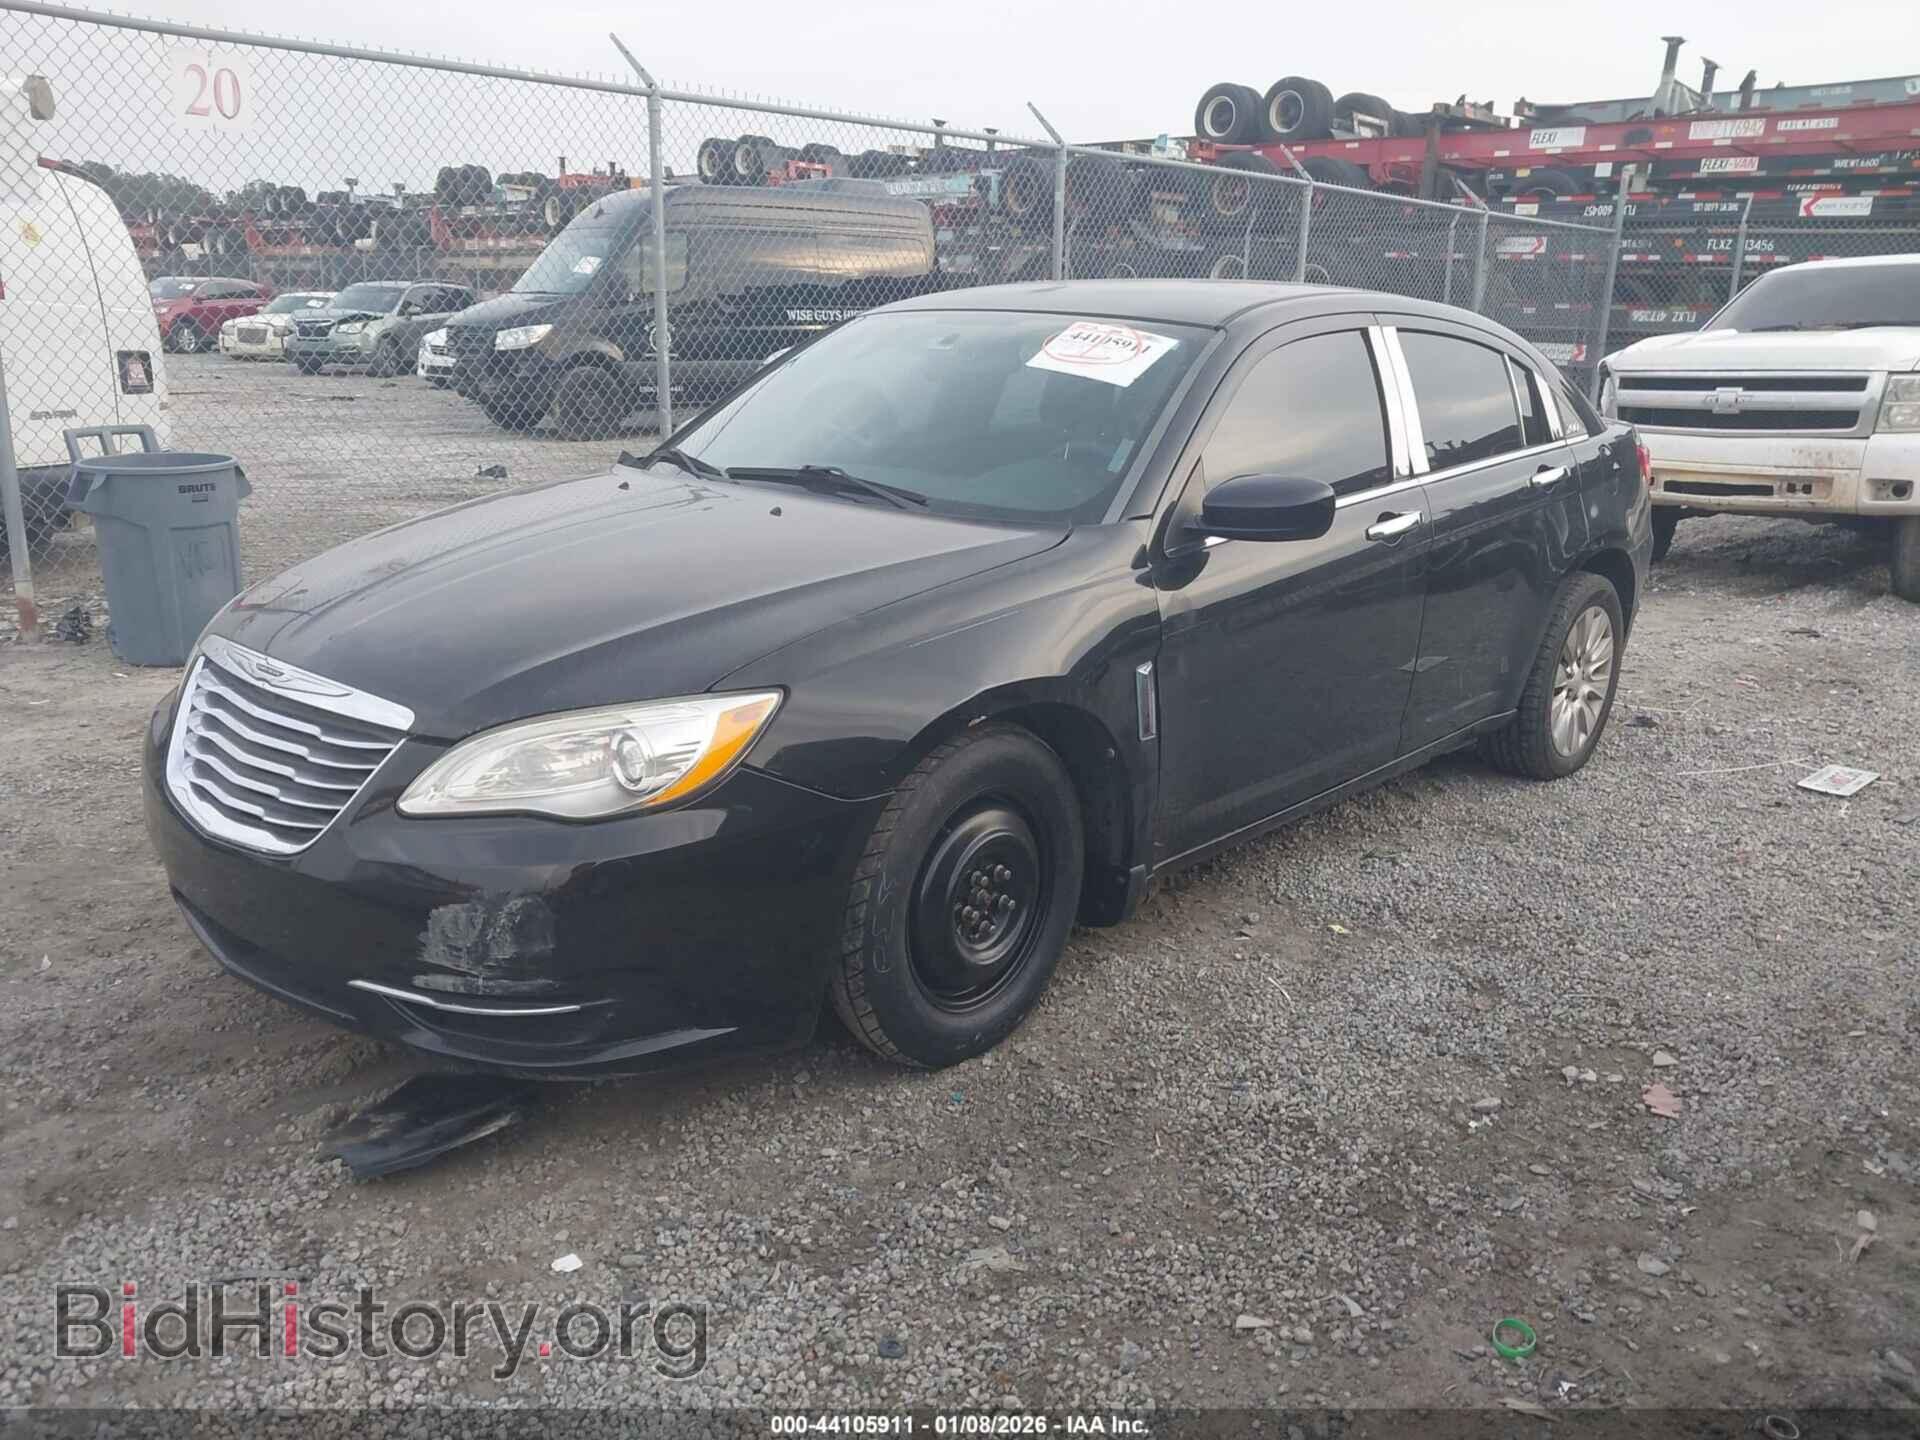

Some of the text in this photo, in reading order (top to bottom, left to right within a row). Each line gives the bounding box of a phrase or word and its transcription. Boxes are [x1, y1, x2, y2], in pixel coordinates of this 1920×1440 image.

[184, 64, 241, 120] 20
[1706, 239, 1733, 250] FLXZ
[786, 309, 814, 321] WISE
[814, 309, 842, 321] GUYS
[177, 483, 216, 494] BRUTE
